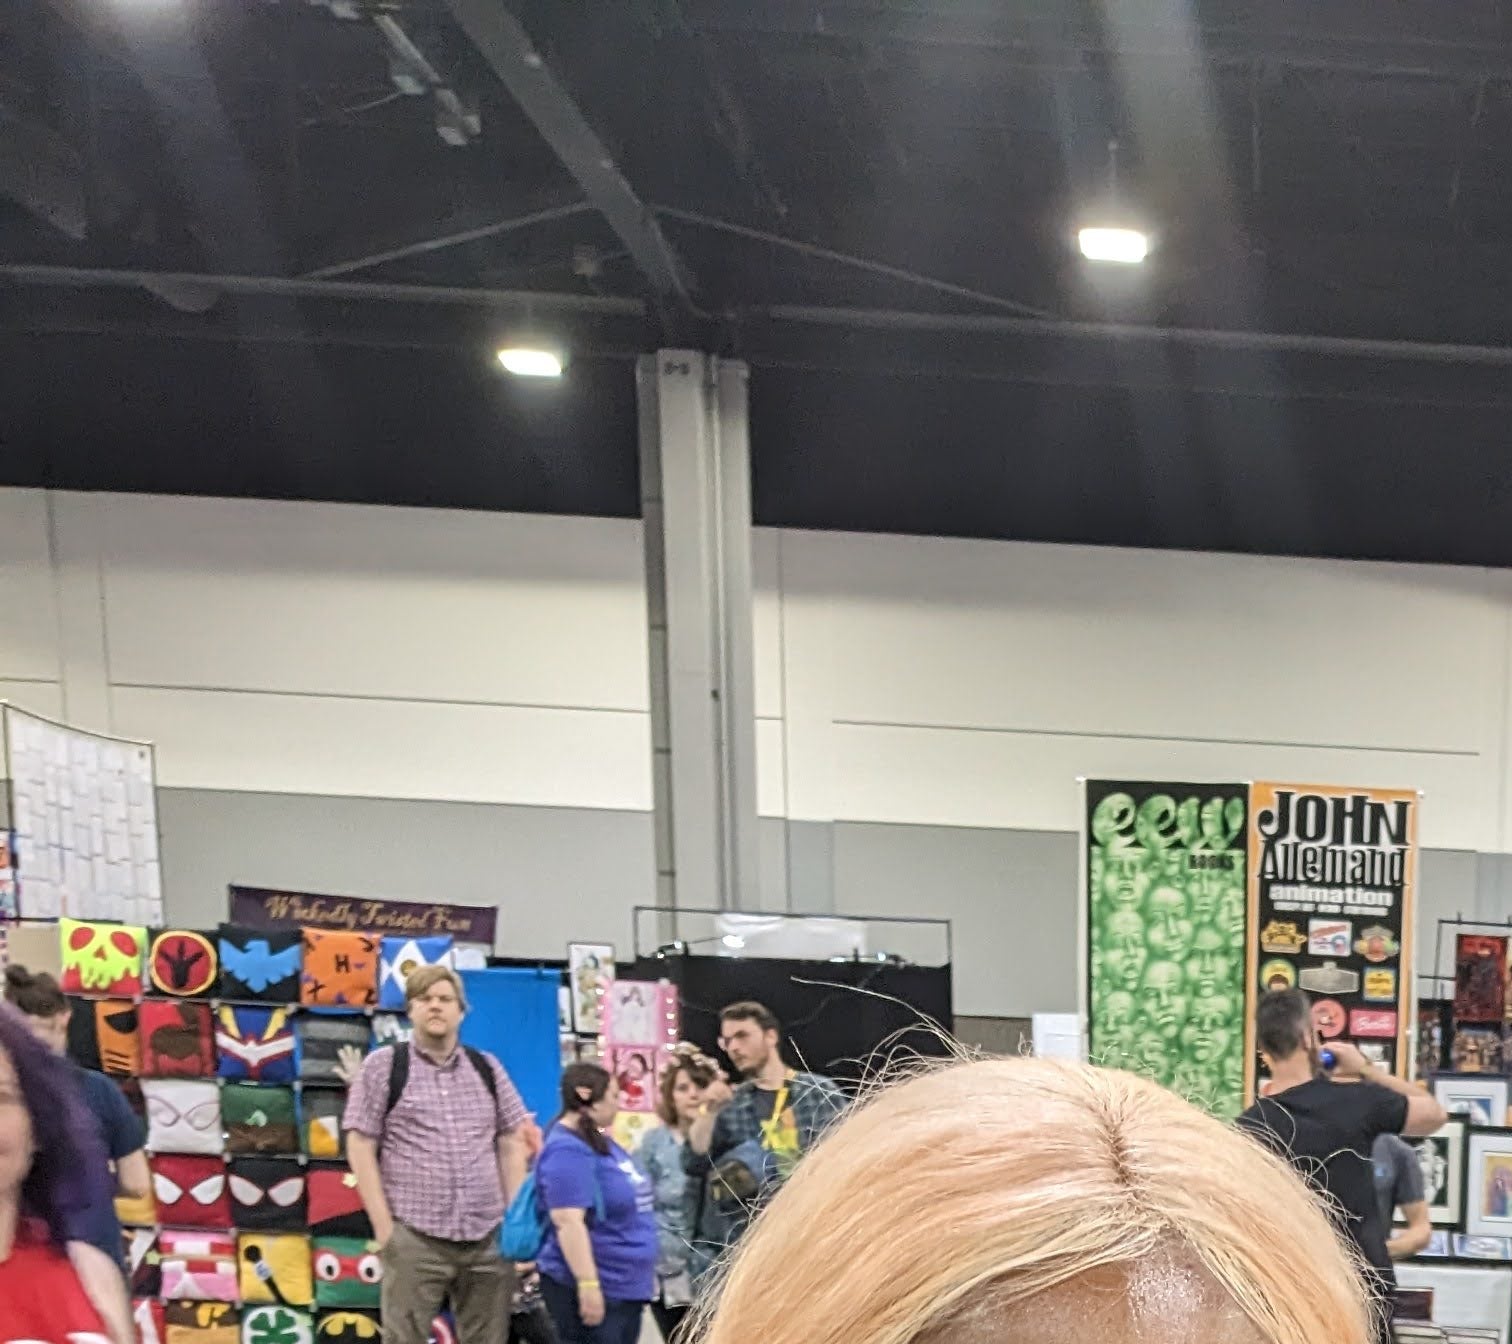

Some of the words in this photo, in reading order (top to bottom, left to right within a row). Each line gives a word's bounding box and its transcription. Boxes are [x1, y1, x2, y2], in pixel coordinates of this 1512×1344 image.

[1257, 790, 1411, 847] JOHN
[1257, 840, 1410, 887] Allemand
[1269, 884, 1393, 906] animation
